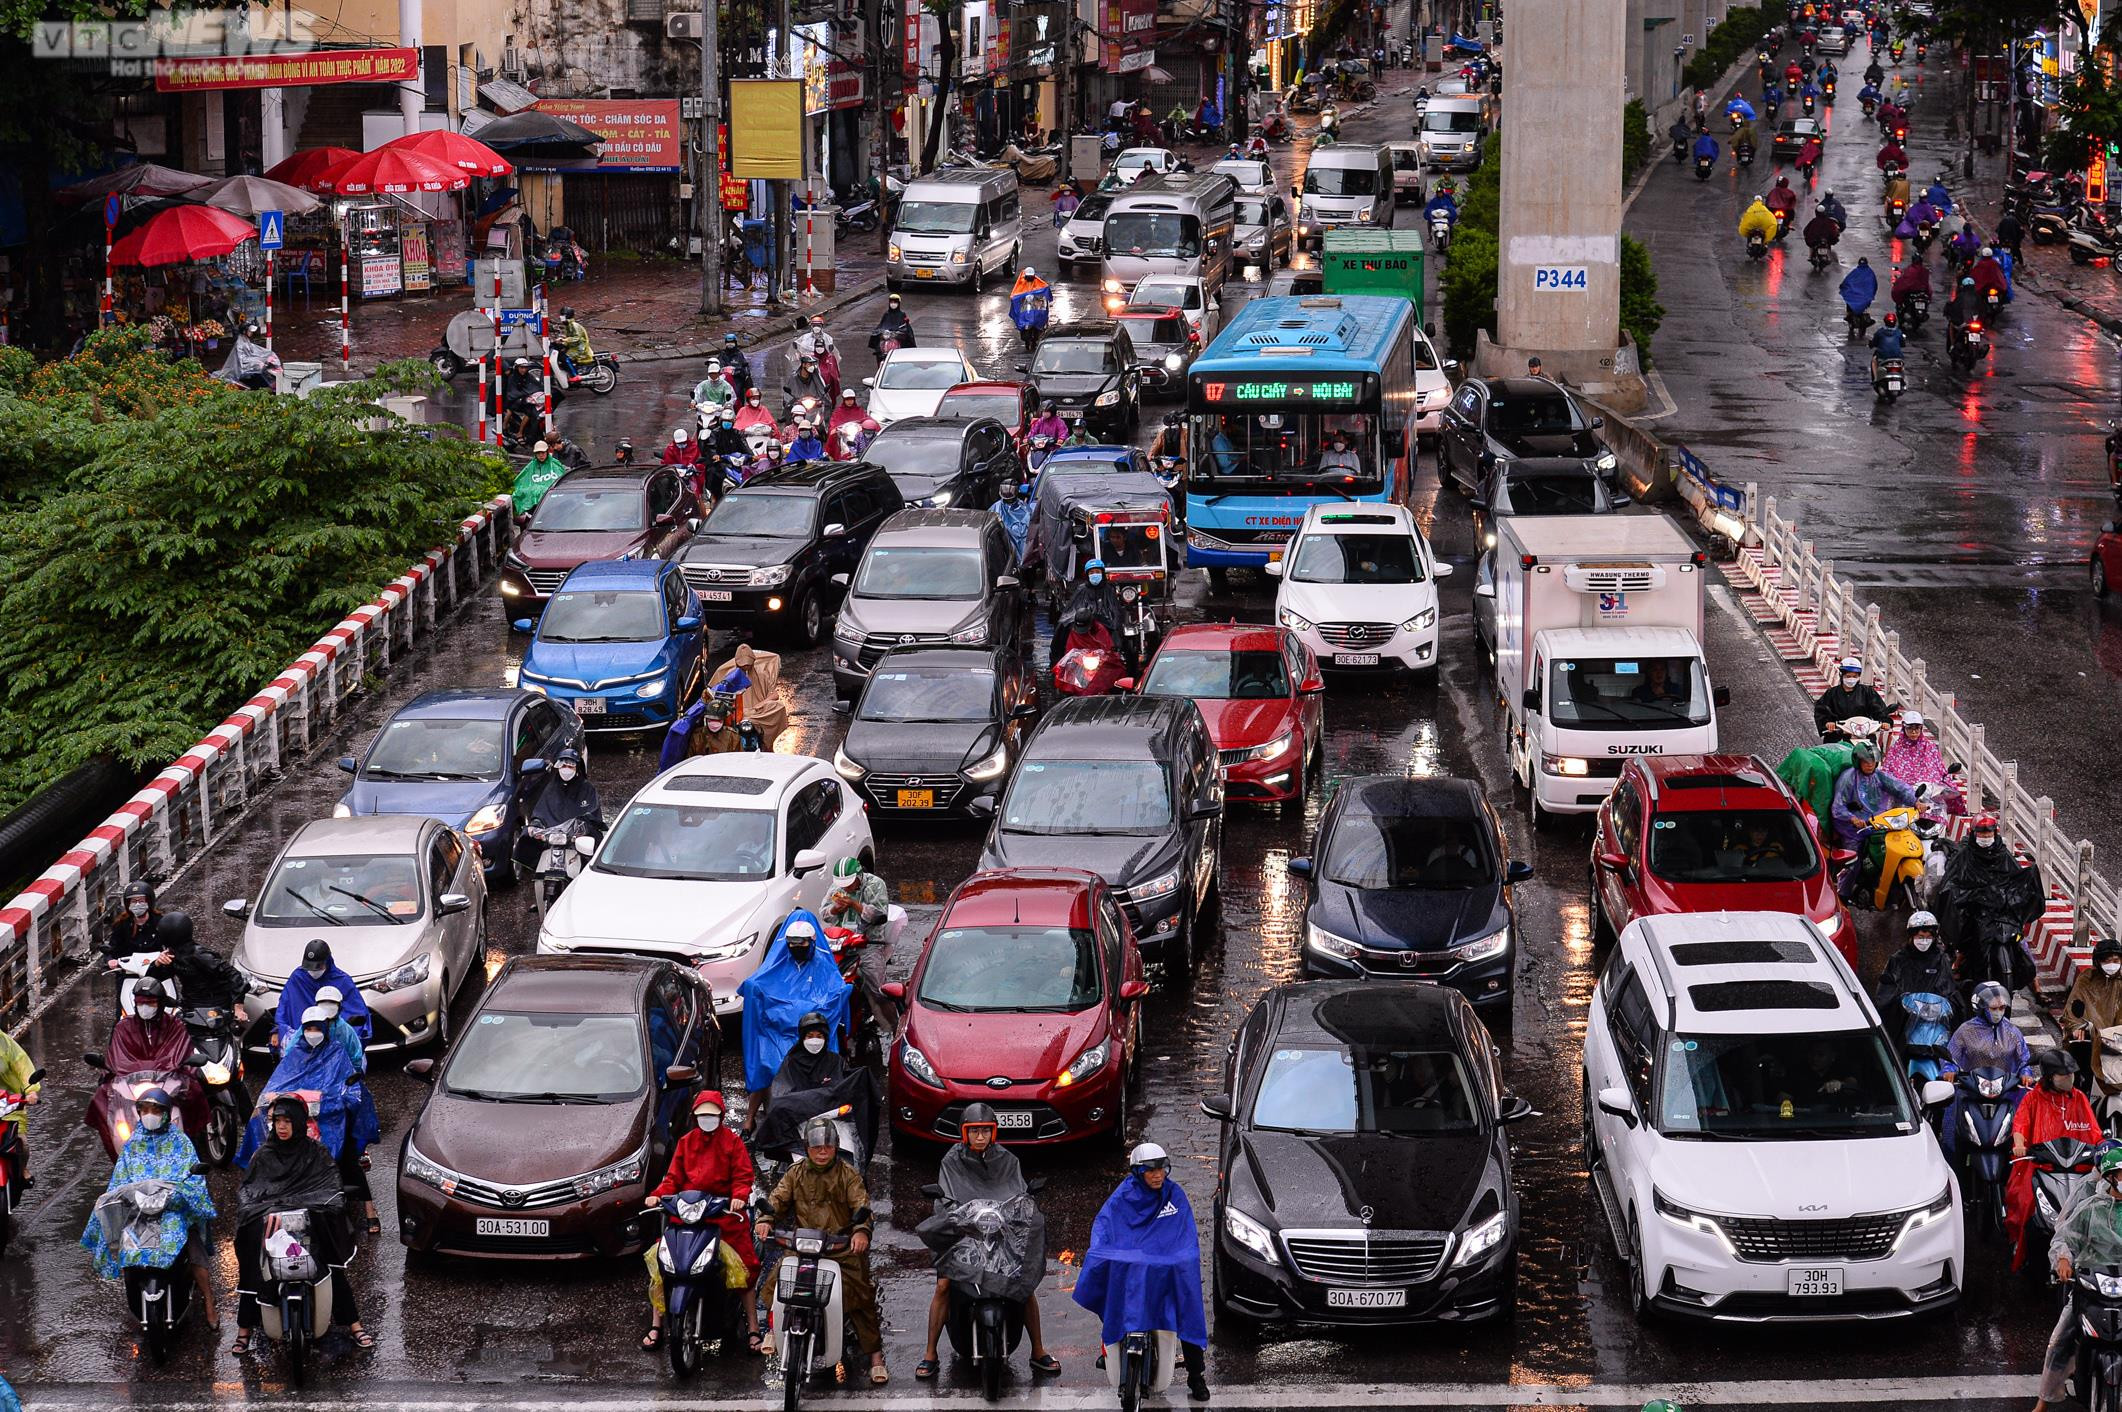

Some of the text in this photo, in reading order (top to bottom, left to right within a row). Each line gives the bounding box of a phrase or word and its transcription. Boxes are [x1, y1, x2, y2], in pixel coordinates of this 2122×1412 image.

[265, 60, 282, 80] HÀNH
[284, 60, 301, 82] ĐỘNG
[302, 58, 308, 78] VÌ
[309, 60, 318, 77] AN
[319, 58, 336, 77] TOÀN
[336, 58, 351, 79] THỰC
[375, 56, 390, 74] NĂM
[390, 57, 406, 74] 2022
[579, 113, 597, 124] TÓC
[605, 113, 631, 124] CHĂM
[634, 113, 652, 124] SÓC
[627, 128, 645, 139] CẮT
[633, 142, 644, 153] CÔ
[1343, 257, 1407, 270] XE THƯ BÁO
[1536, 269, 1586, 288] P344
[1206, 383, 1226, 400] 07
[1312, 382, 1331, 400] NỘI
[1333, 382, 1353, 398] BÀI
[1245, 516, 1257, 526] CT
[1259, 516, 1270, 526] XE
[1607, 745, 1663, 754] SUZUKI
[902, 799, 929, 807] 202.39
[478, 1220, 547, 1235] 30A-531.00
[1804, 1269, 1828, 1281] 30H
[1794, 1282, 1838, 1294] 793.93
[1329, 1291, 1404, 1306] 30A-670.77
